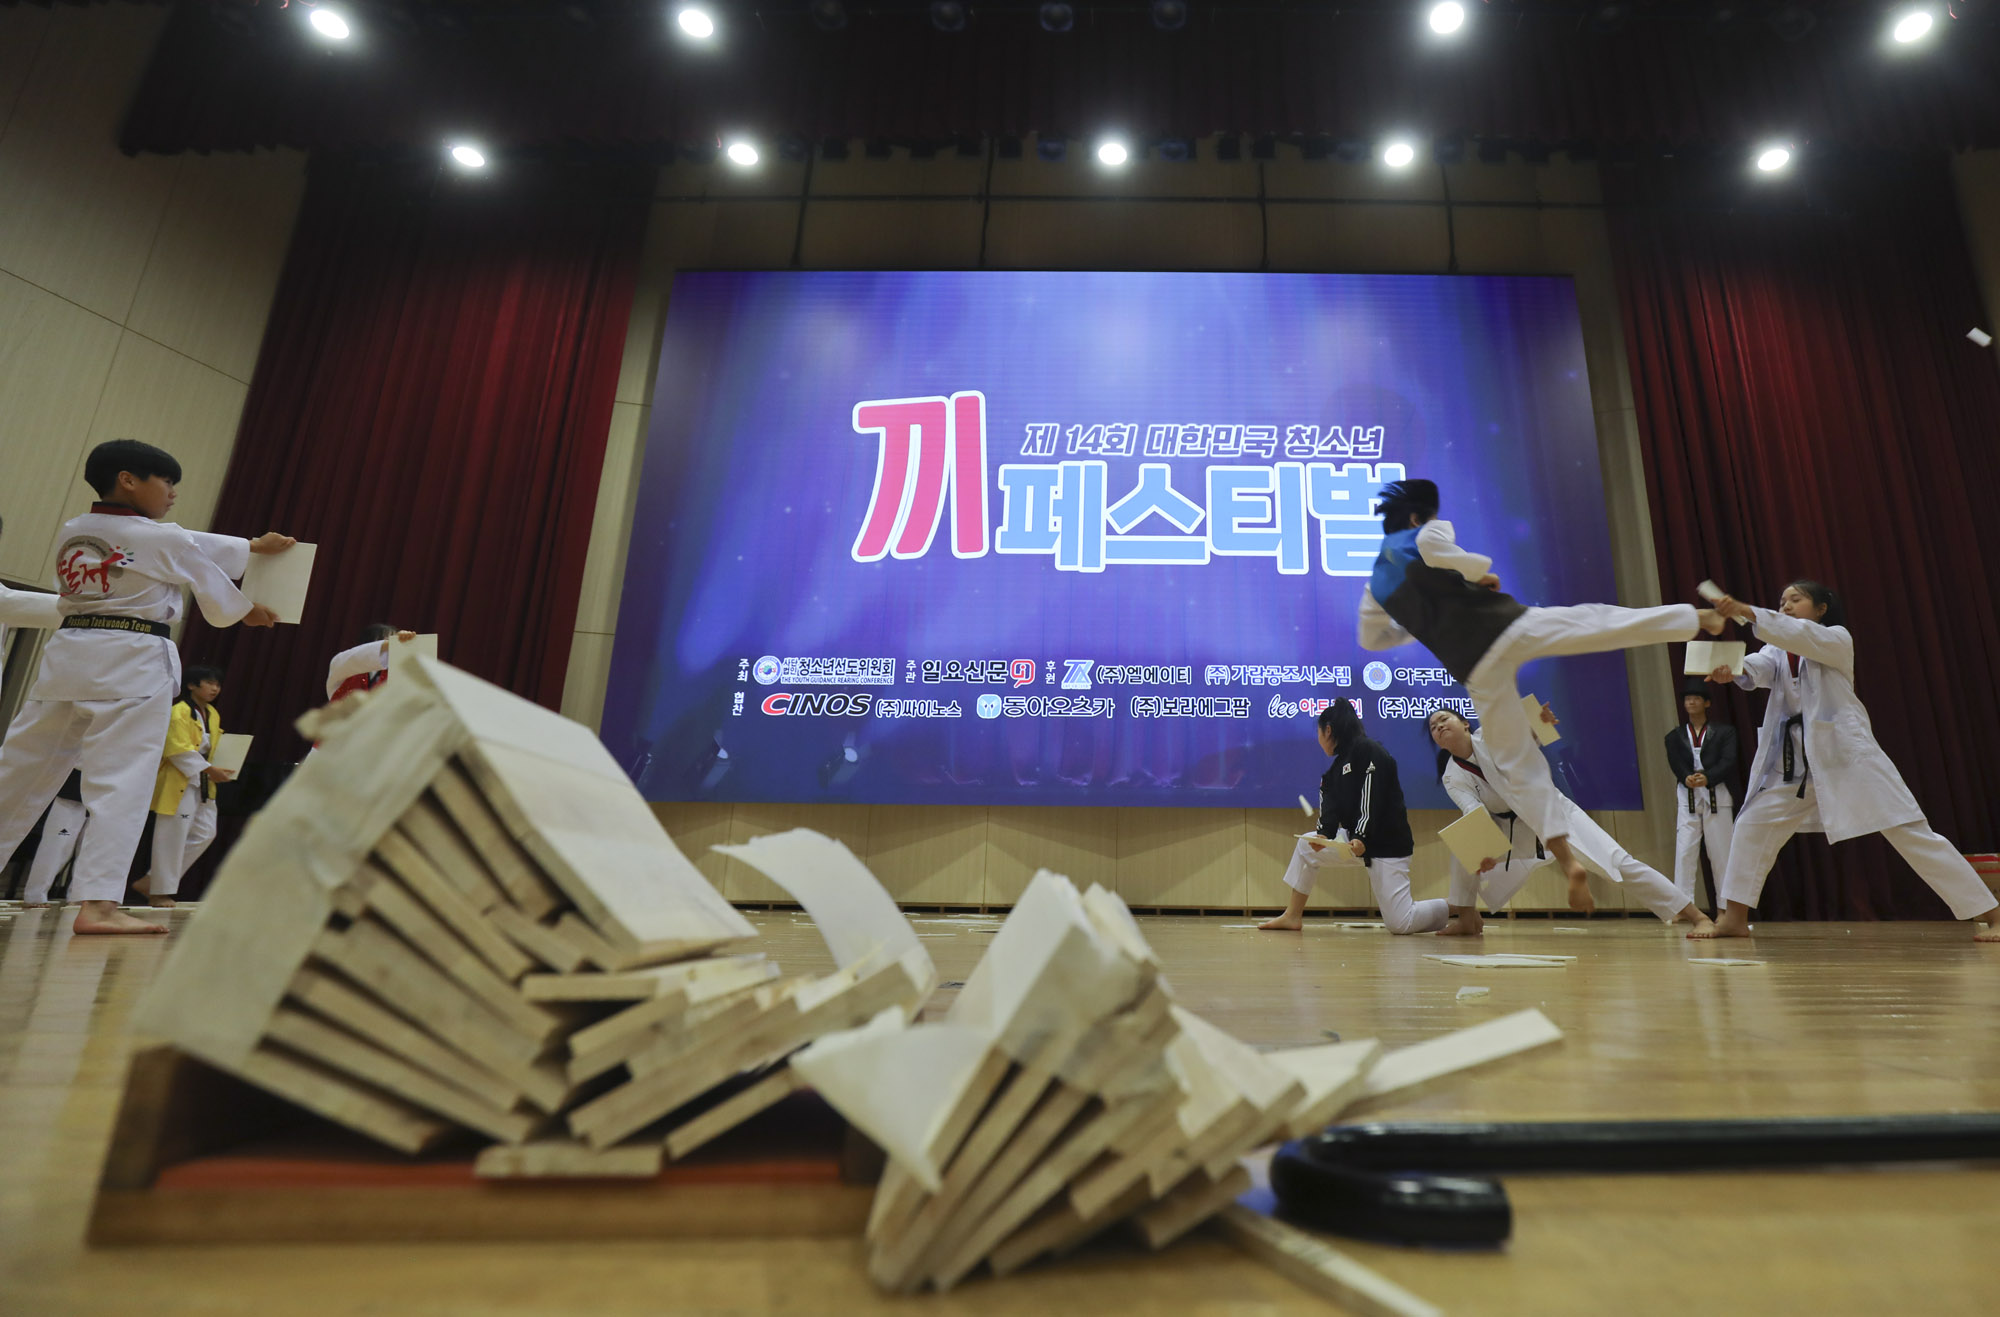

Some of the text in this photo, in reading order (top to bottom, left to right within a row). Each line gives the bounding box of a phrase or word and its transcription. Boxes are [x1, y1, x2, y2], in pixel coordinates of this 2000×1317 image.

[1021, 423, 1384, 459] 제 14회 대한민국 청소년
[852, 390, 1406, 576] 끼 페스티벌
[91, 617, 129, 629] Taekwondo
[132, 620, 152, 632] Team
[736, 658, 750, 682] 주최
[798, 657, 896, 677] 청소년선도위원회
[905, 659, 917, 683] 주관
[922, 659, 1009, 683] 일요신문
[1045, 660, 1057, 685] 후원
[1096, 665, 1192, 685] (주)엘에이티
[1205, 664, 1352, 686] (주)가람공조시스템
[1394, 668, 1457, 686] 아주대
[732, 691, 745, 716] 협찬
[761, 693, 872, 716] CINOS
[875, 699, 962, 718] (주)싸이노스
[1002, 695, 1116, 718] 동아오츠카
[1131, 696, 1251, 718] (주)보라에그팜
[1268, 694, 1299, 718] lee
